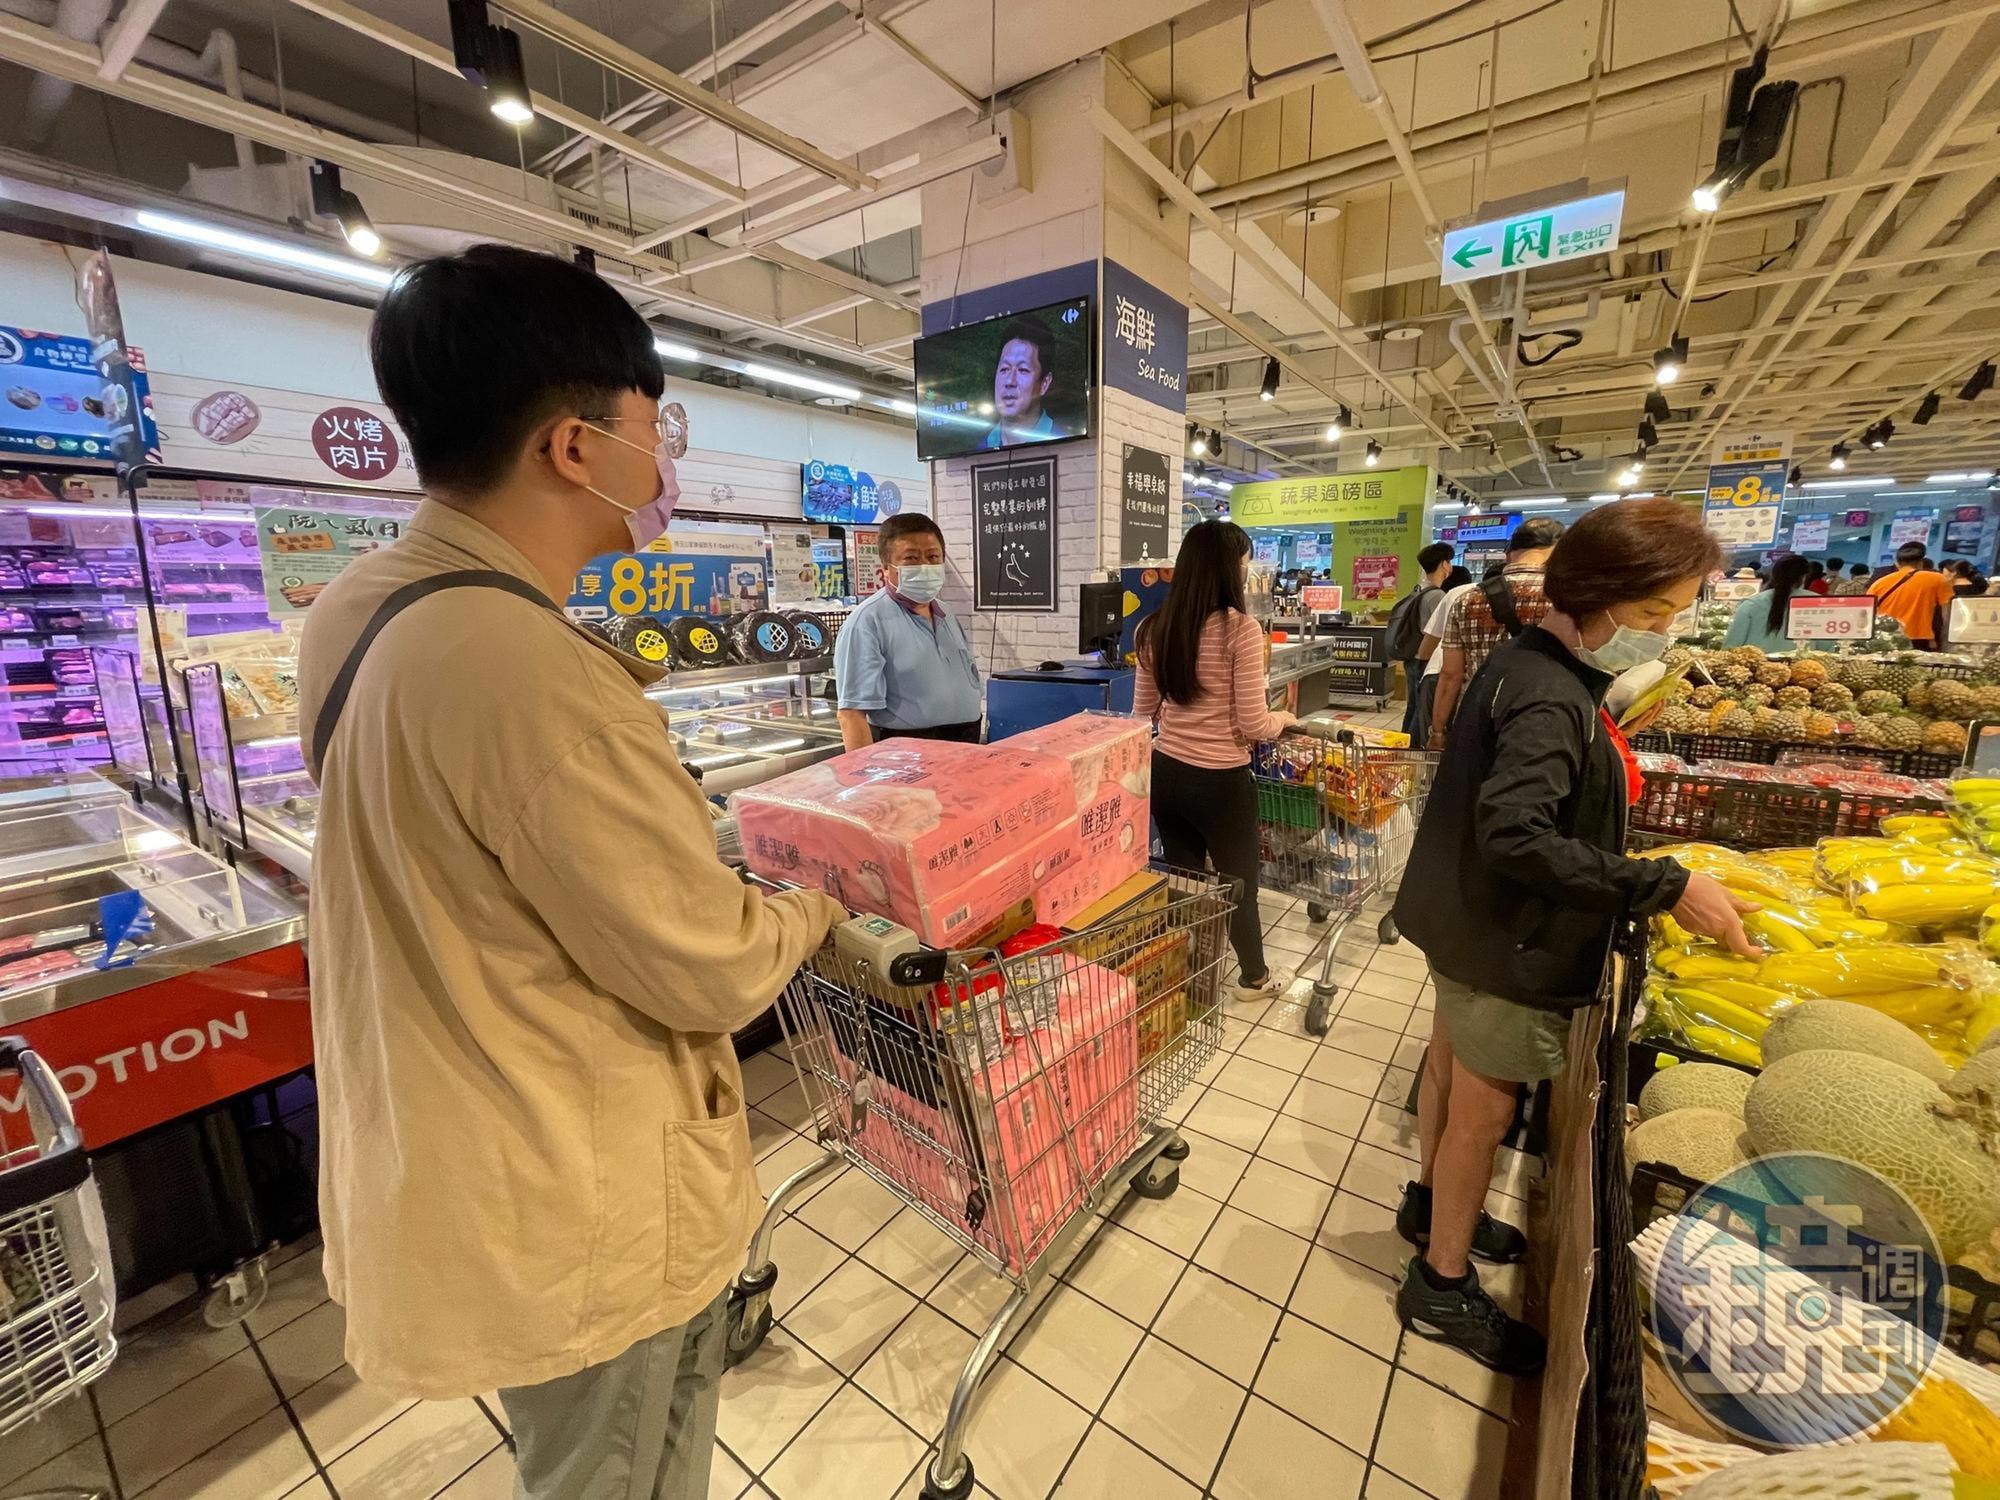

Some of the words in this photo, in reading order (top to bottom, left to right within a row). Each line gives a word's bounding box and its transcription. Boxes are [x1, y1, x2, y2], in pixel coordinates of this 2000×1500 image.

[1557, 223, 1612, 247] 緊急出口
[1558, 238, 1610, 256] EXIT
[1115, 294, 1155, 355] 海鮮
[1137, 358, 1156, 381] Sea
[1158, 367, 1181, 391] Food
[322, 415, 384, 443] 火烤
[329, 444, 388, 470] 肉片
[1279, 480, 1384, 506] 蔬果過磅區
[609, 557, 695, 615] 8折
[1825, 620, 1851, 634] 89
[1081, 794, 1122, 841] 唯潔雅
[754, 832, 801, 871] 唯潔雅
[928, 843, 959, 872] 唯潔雅
